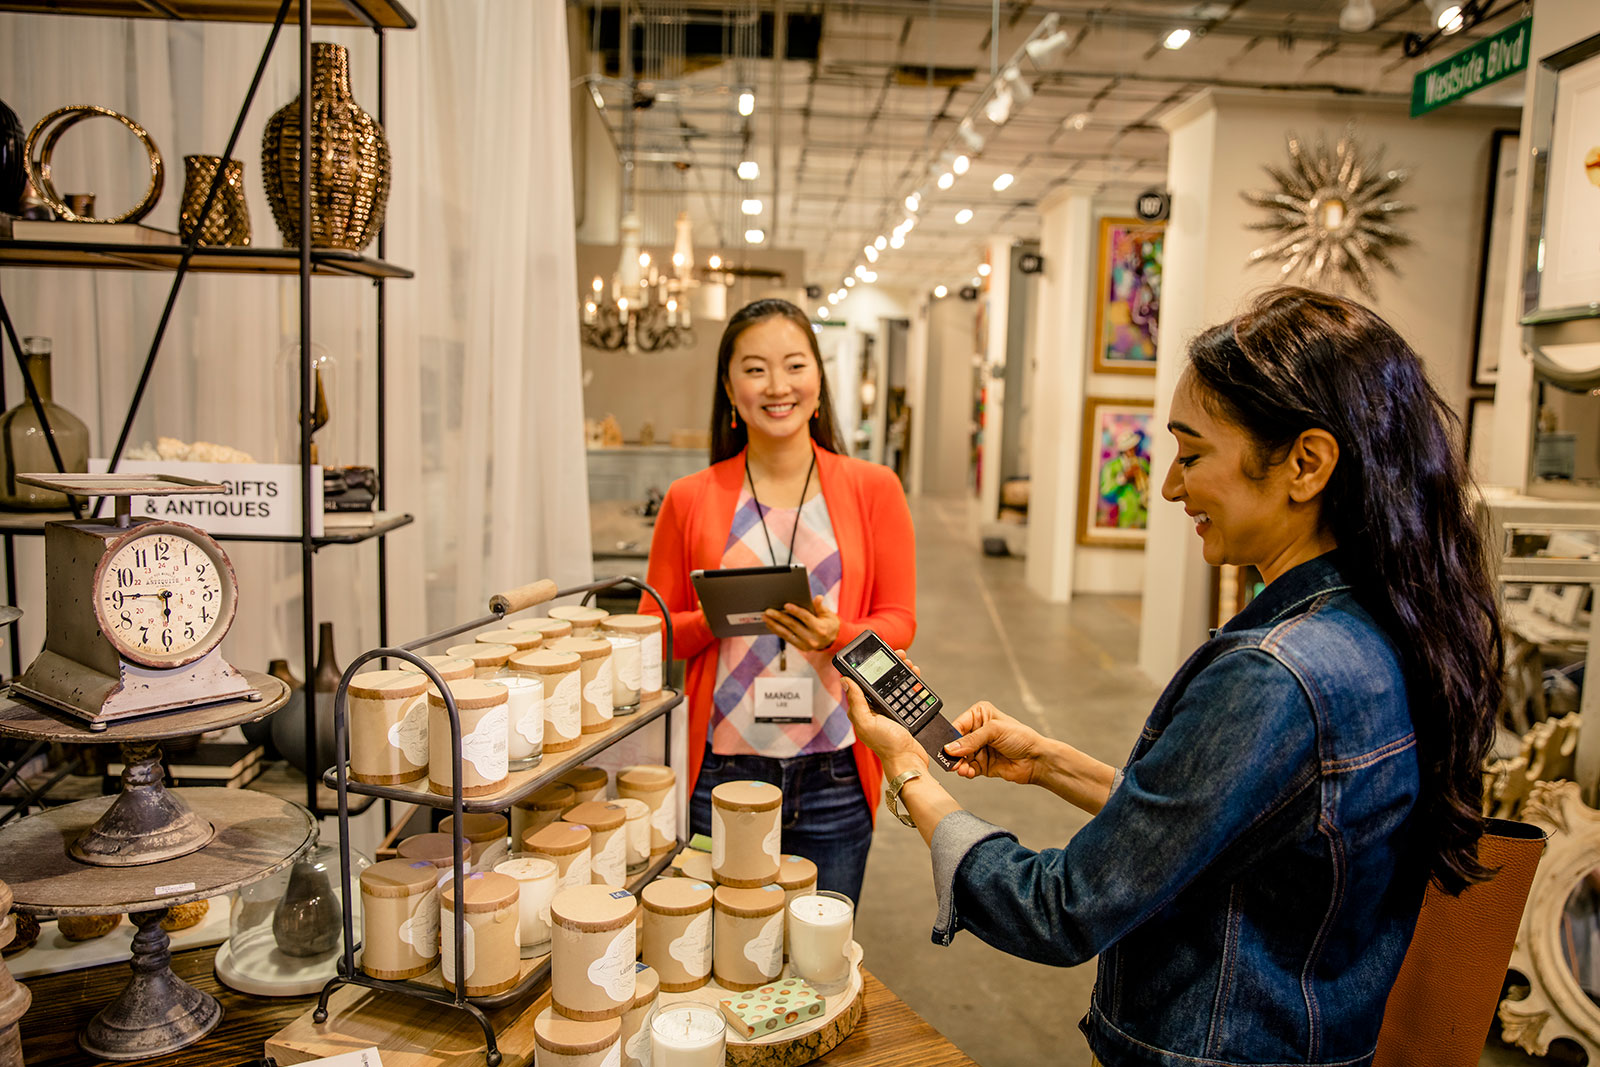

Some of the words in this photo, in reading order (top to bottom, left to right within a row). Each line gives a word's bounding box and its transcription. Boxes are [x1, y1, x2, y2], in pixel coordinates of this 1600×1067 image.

[1424, 51, 1485, 105] Westside
[1487, 27, 1525, 78] Blvd
[221, 480, 278, 497] GIFTS
[145, 499, 157, 514] &
[165, 500, 270, 518] ANTIQUES
[135, 549, 147, 568] 11
[154, 542, 170, 561] 12
[117, 567, 133, 588] 10
[195, 564, 206, 582] 2
[112, 590, 124, 610] 9
[120, 610, 132, 630] 8
[198, 606, 209, 623] 4
[139, 626, 149, 644] 7
[162, 628, 173, 647] 6
[184, 621, 194, 639] 5
[937, 751, 950, 768] VISA
